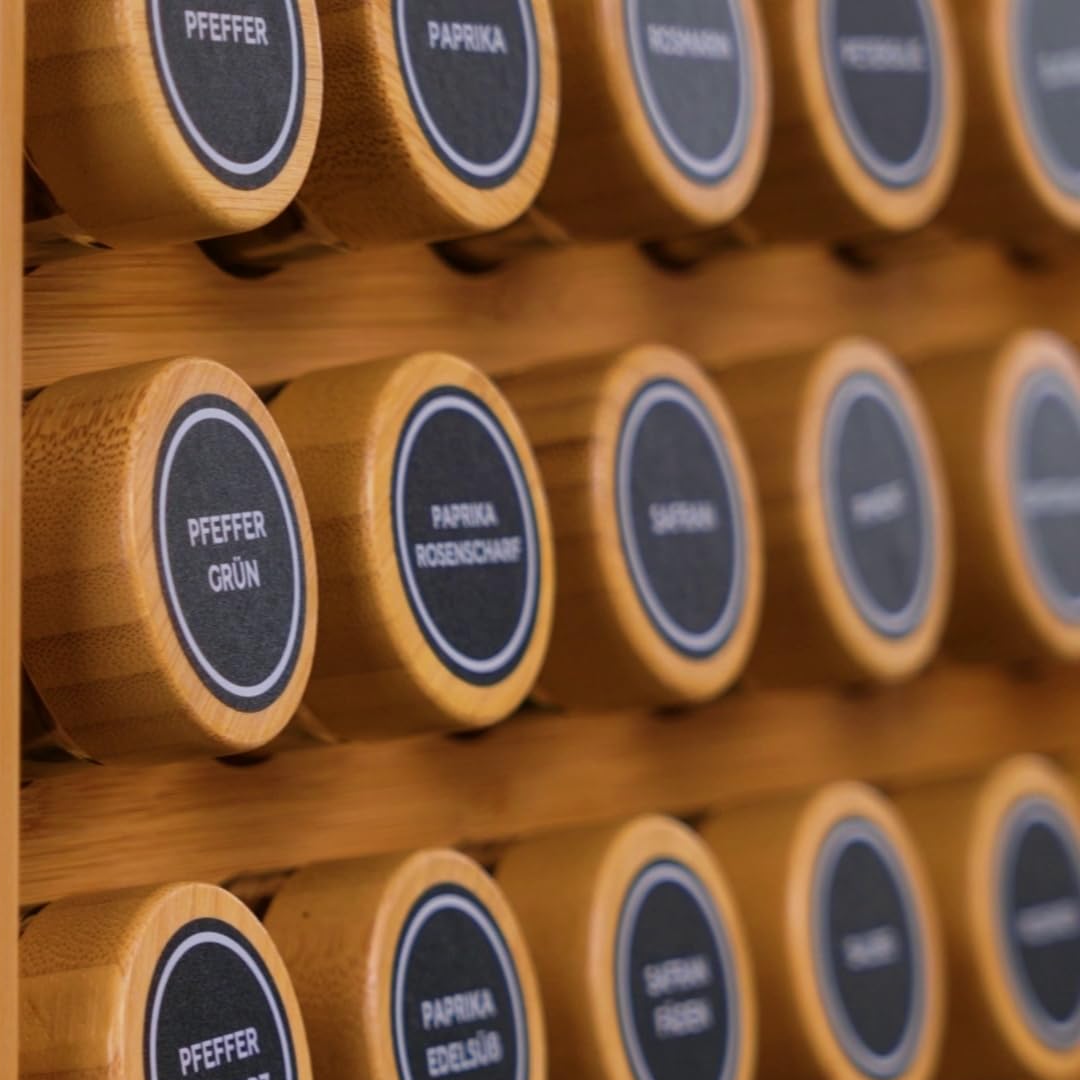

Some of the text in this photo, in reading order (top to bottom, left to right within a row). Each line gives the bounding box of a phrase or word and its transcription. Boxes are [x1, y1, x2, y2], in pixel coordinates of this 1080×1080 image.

[184, 9, 269, 46] PFEFFER
[428, 20, 507, 54] PAPRIKA
[187, 510, 268, 547] PFEFFER
[430, 501, 498, 530] PAPRIKA
[414, 536, 523, 569] ROSENSCHARF
[207, 556, 261, 593] GRÜN
[420, 988, 497, 1031] PAPRIKA
[178, 1026, 260, 1076] PFEFFER
